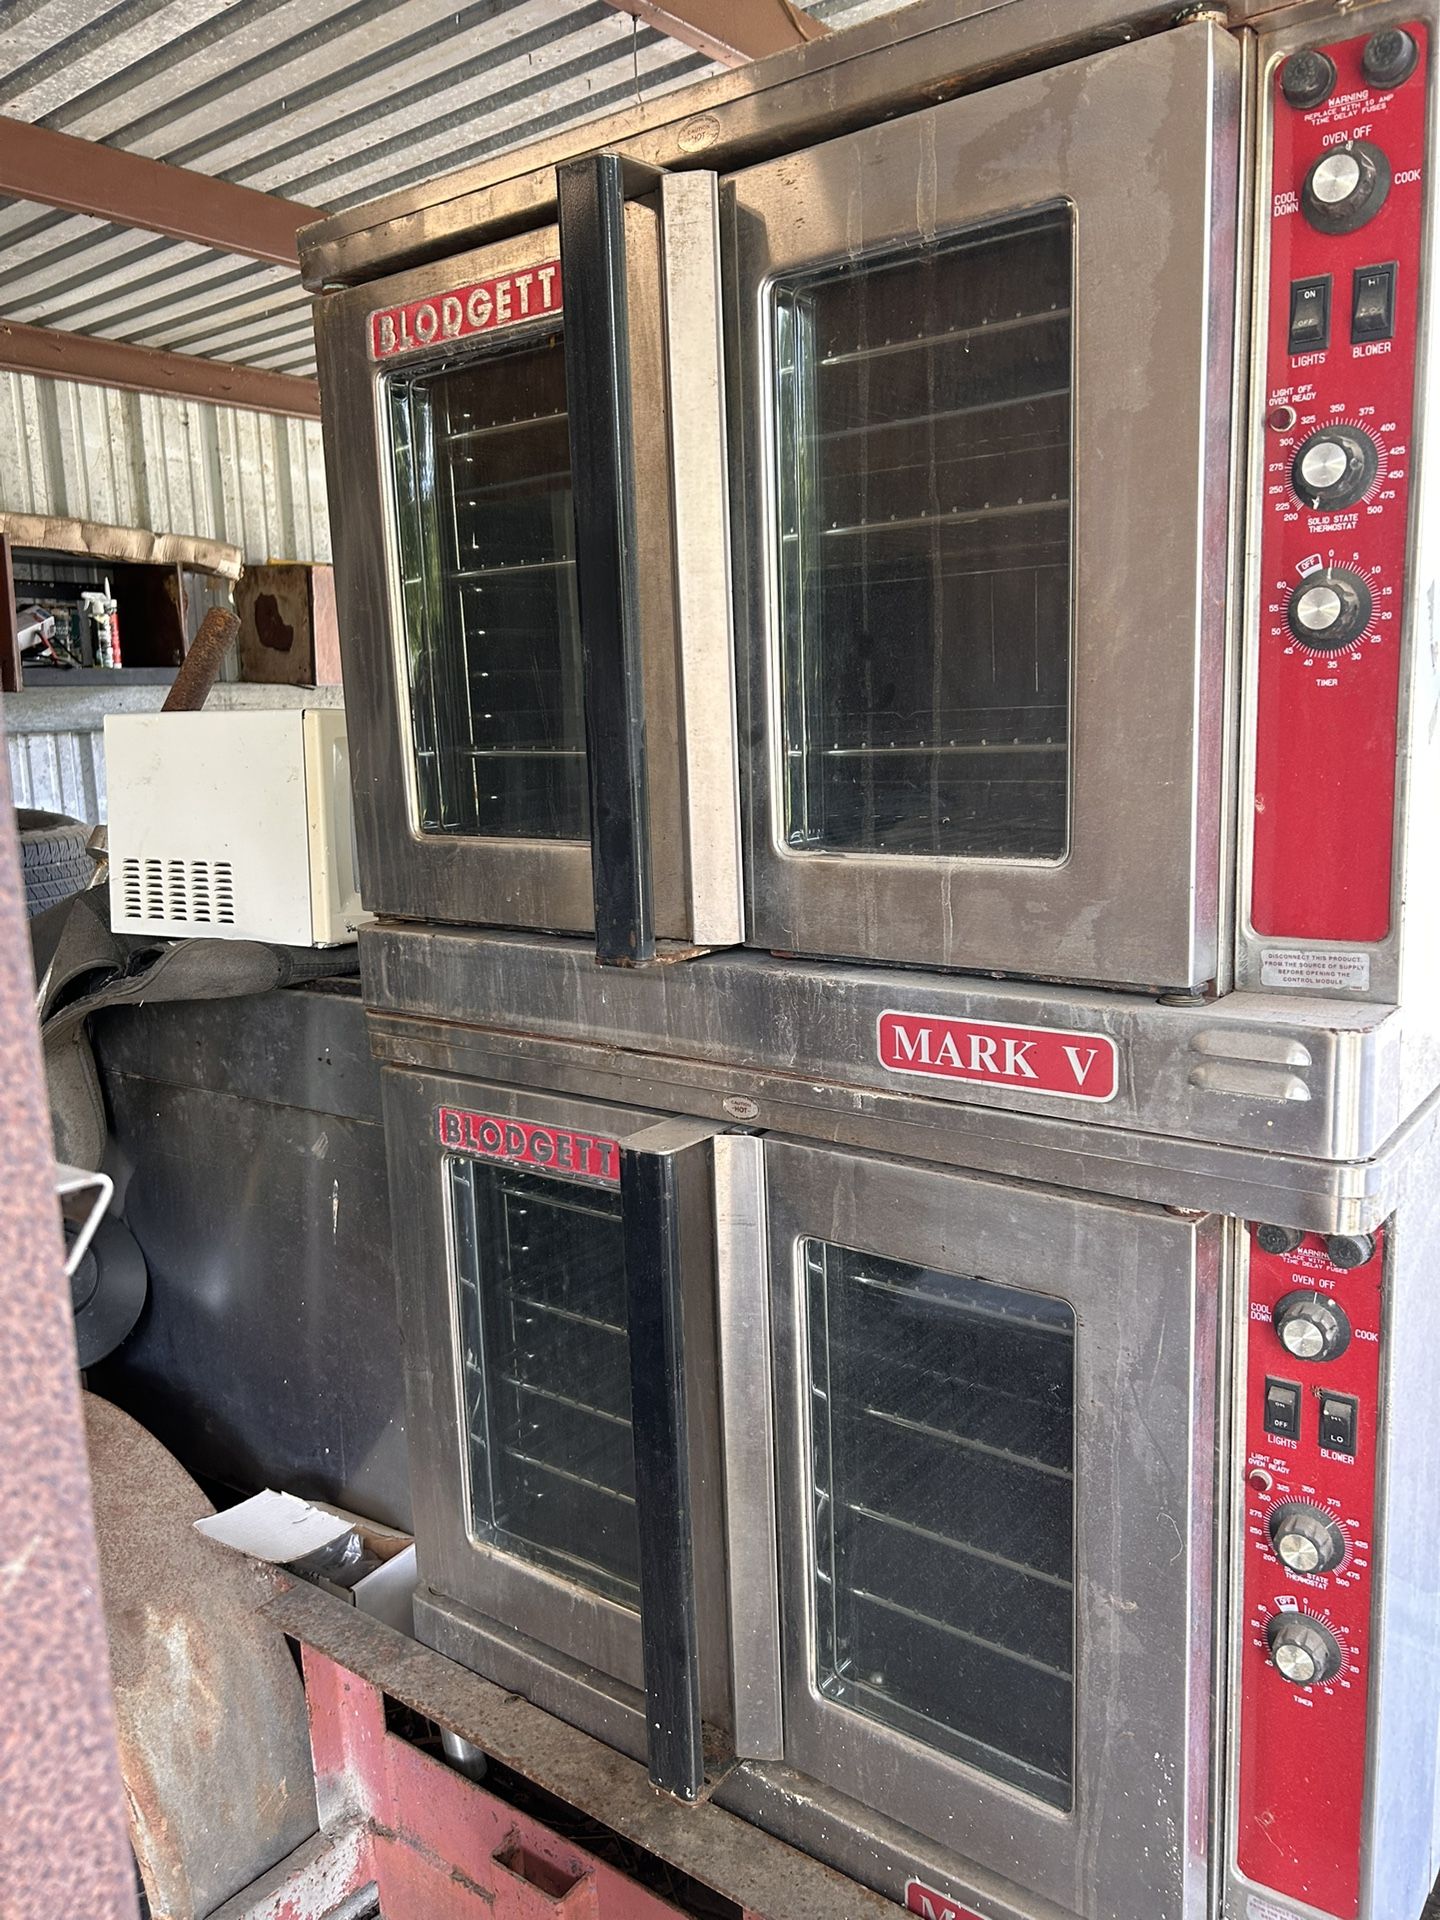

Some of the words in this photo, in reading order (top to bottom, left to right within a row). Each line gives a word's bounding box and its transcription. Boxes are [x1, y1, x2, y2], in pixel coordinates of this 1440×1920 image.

[1328, 90, 1368, 106] WARNING
[1304, 108, 1337, 121] REPLACE
[1341, 103, 1360, 112] WITH
[1379, 94, 1394, 103] AMP
[1312, 116, 1330, 126] TIME
[1334, 110, 1358, 121] DELAY
[1362, 103, 1386, 114] FUSES
[1322, 130, 1349, 146] OVEN
[1353, 125, 1373, 140] OFF
[1394, 169, 1421, 184] COOK
[1274, 191, 1298, 205] COOL
[1274, 202, 1299, 217] DOWN
[1304, 290, 1316, 299] ON
[379, 266, 556, 351] BLODGETT
[1298, 318, 1314, 327] OFF
[1352, 342, 1391, 359] BLOWER
[1292, 353, 1326, 368] LIGHTS
[1272, 387, 1294, 398] LIGHT
[1298, 384, 1313, 394] OFF
[1269, 396, 1288, 407] OVEN
[1292, 392, 1317, 403] READY
[1330, 404, 1345, 413] 350
[1359, 407, 1375, 416] 375
[1301, 416, 1316, 424] 325
[1380, 423, 1396, 432] 400
[1280, 438, 1294, 446] 300
[1390, 446, 1406, 455] 425
[1269, 463, 1284, 472] 275
[1388, 470, 1404, 479] 450
[1269, 486, 1283, 494] 250
[1380, 490, 1396, 499] 475
[1275, 502, 1290, 511] 225
[1367, 506, 1383, 514] 500
[1284, 513, 1298, 522] 200
[1308, 516, 1330, 526] SOLID
[1334, 513, 1359, 522] STATE
[1309, 522, 1357, 534] THERMOSTAT
[1328, 549, 1334, 557] 0
[1353, 552, 1359, 560] 5
[1301, 558, 1316, 570] OFF
[1371, 566, 1382, 574] 10
[1276, 581, 1286, 589] 60
[1382, 587, 1392, 596] 15
[1269, 604, 1278, 612] 55
[1382, 612, 1392, 620] 20
[1272, 628, 1281, 636] 50
[1370, 635, 1382, 643] 25
[1284, 647, 1294, 655] 45
[1351, 652, 1362, 660] 30
[1304, 658, 1314, 666] 40
[1316, 678, 1338, 686] TIMER
[892, 1025, 1039, 1079] MARK
[1062, 1046, 1098, 1086] V
[734, 1106, 748, 1114] HOT
[444, 1112, 615, 1175] BLODGETT
[1283, 1258, 1299, 1266] TIME
[1302, 1261, 1323, 1269] DELAY
[1326, 1266, 1348, 1275] FUSES
[1292, 1274, 1314, 1286] OVEN
[1319, 1278, 1336, 1290] OFF
[1250, 1302, 1272, 1314] COOL
[1250, 1311, 1272, 1322] DOWN
[1354, 1329, 1379, 1342] COOK
[1274, 1419, 1288, 1428] OFF
[1268, 1434, 1297, 1450] LIGHTS
[1330, 1434, 1344, 1443] LO
[1251, 1452, 1270, 1462] LIGHT
[1273, 1458, 1287, 1466] OFF
[1320, 1448, 1354, 1466] BLOWER
[1248, 1458, 1266, 1468] OVEN
[1268, 1463, 1290, 1474] READY
[1302, 1484, 1316, 1494] 350
[1258, 1492, 1271, 1502] 300
[1327, 1498, 1342, 1508] 375
[1250, 1508, 1262, 1518] 275
[1346, 1518, 1360, 1528] 400
[1250, 1526, 1262, 1536] 250
[1255, 1542, 1268, 1552] 225
[1354, 1540, 1368, 1550] 425
[1263, 1554, 1276, 1563] 200
[1353, 1558, 1368, 1568] 450
[1306, 1572, 1328, 1584] STATE
[1346, 1571, 1360, 1580] 475
[1336, 1578, 1350, 1587] 500
[1324, 1688, 1334, 1696] 30
[1294, 1695, 1313, 1708] TIMER
